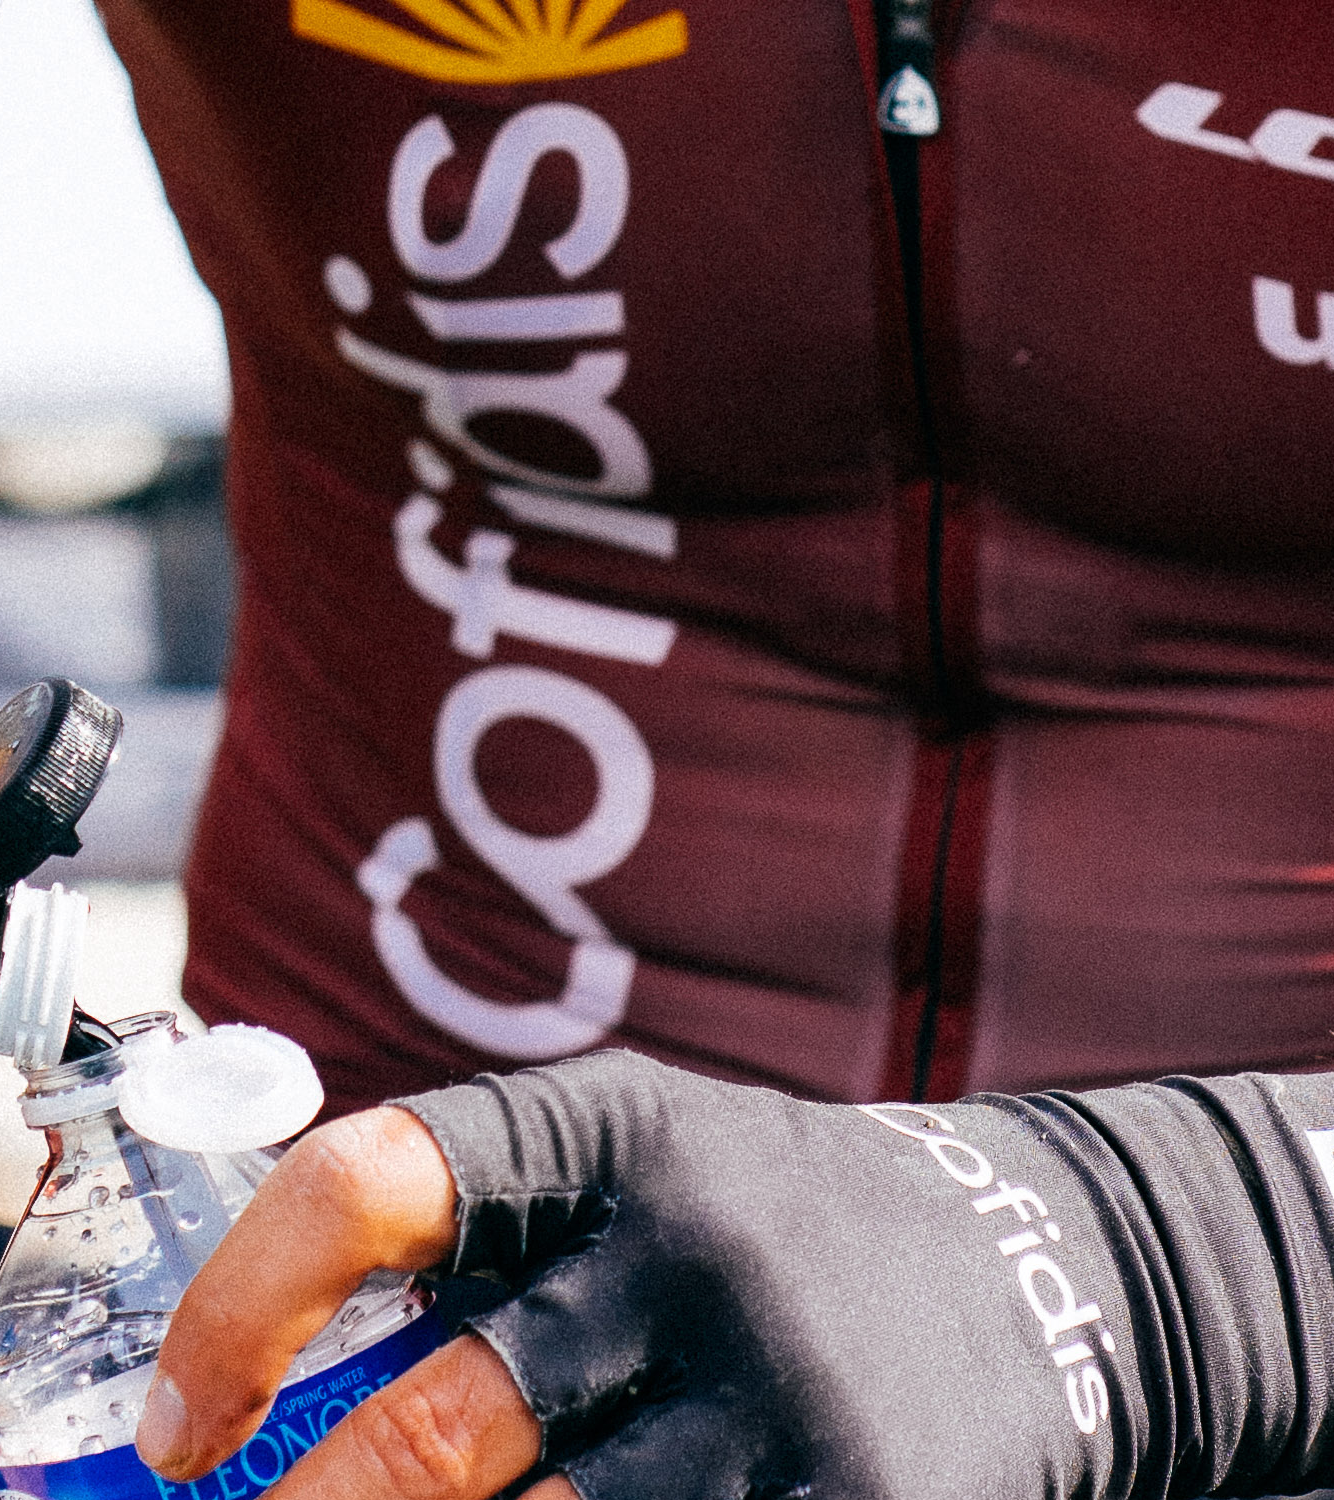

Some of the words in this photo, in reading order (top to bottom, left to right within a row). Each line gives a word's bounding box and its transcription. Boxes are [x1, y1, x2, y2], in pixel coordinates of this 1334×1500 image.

[322, 101, 678, 1060] Cofidis
[327, 1366, 367, 1395] WATER
[857, 1101, 1117, 1436] Cofidis
